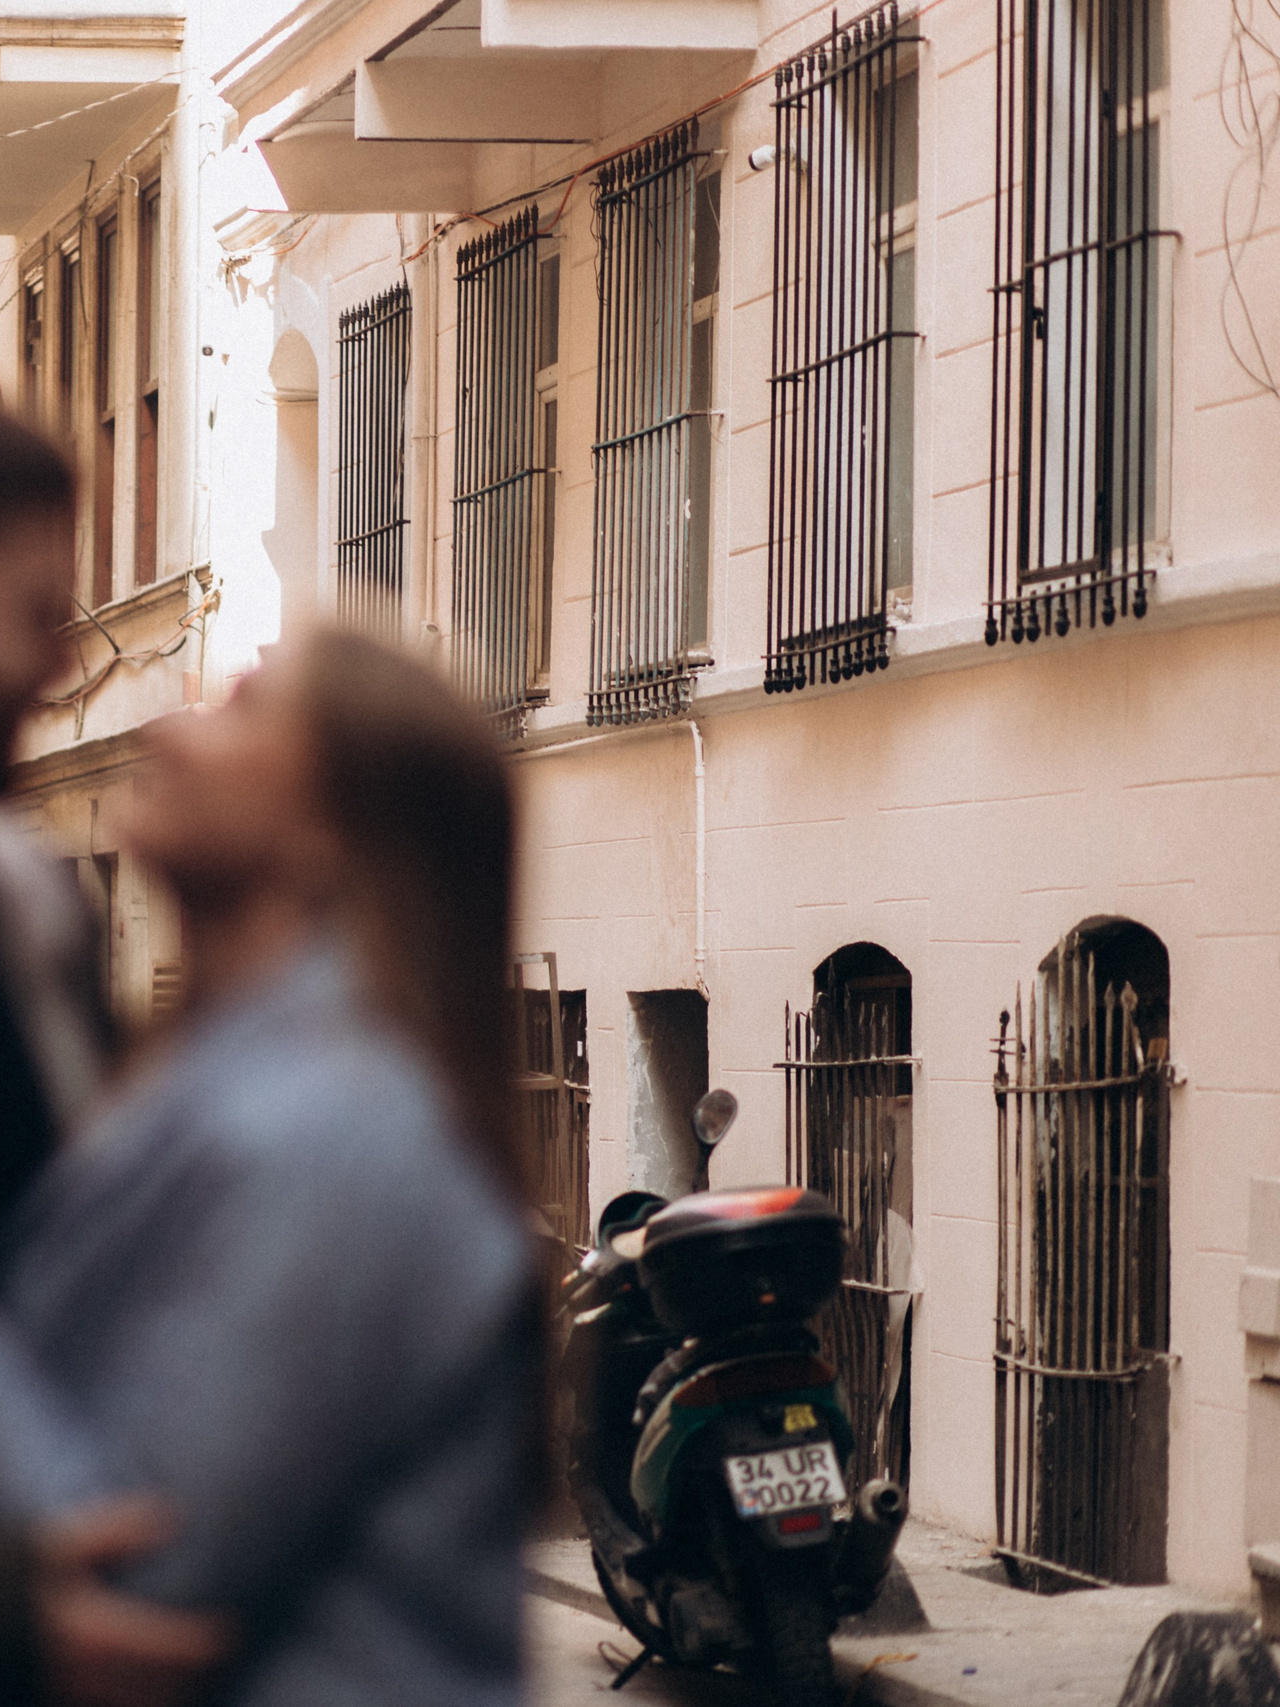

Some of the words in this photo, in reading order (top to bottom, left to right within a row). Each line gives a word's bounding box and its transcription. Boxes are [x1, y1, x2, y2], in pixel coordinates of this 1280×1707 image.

[736, 1457, 774, 1484] 34
[783, 1448, 830, 1476] UR
[758, 1476, 834, 1508] 0022
